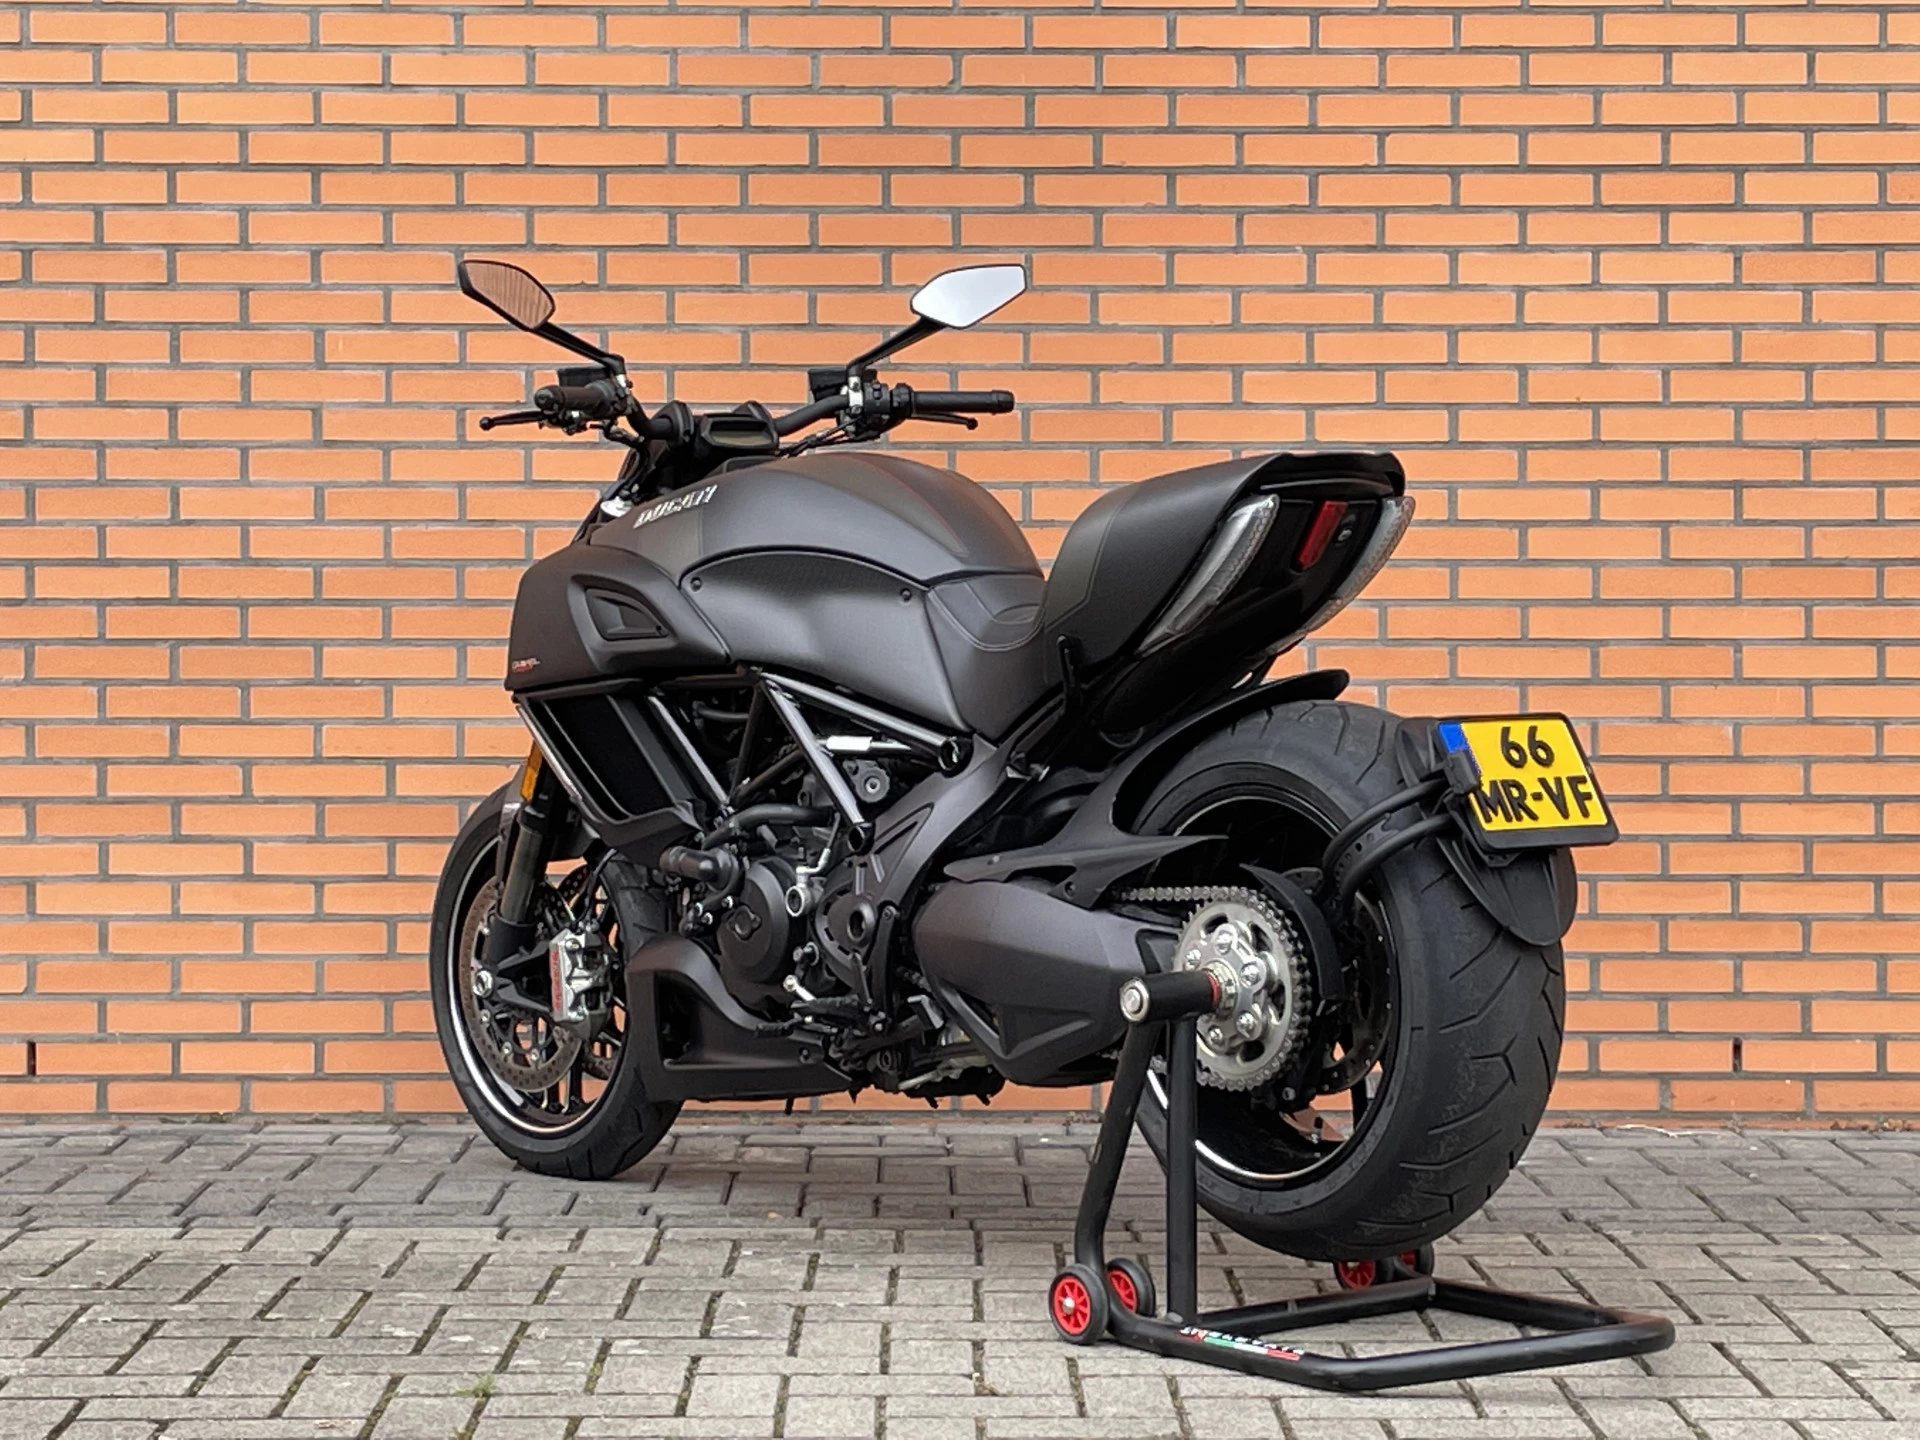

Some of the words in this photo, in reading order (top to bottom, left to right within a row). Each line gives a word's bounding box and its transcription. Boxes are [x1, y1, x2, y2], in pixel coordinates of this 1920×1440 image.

[633, 484, 718, 528] DUCATI
[1500, 725, 1555, 769] 66
[1474, 775, 1593, 823] MR-VF
